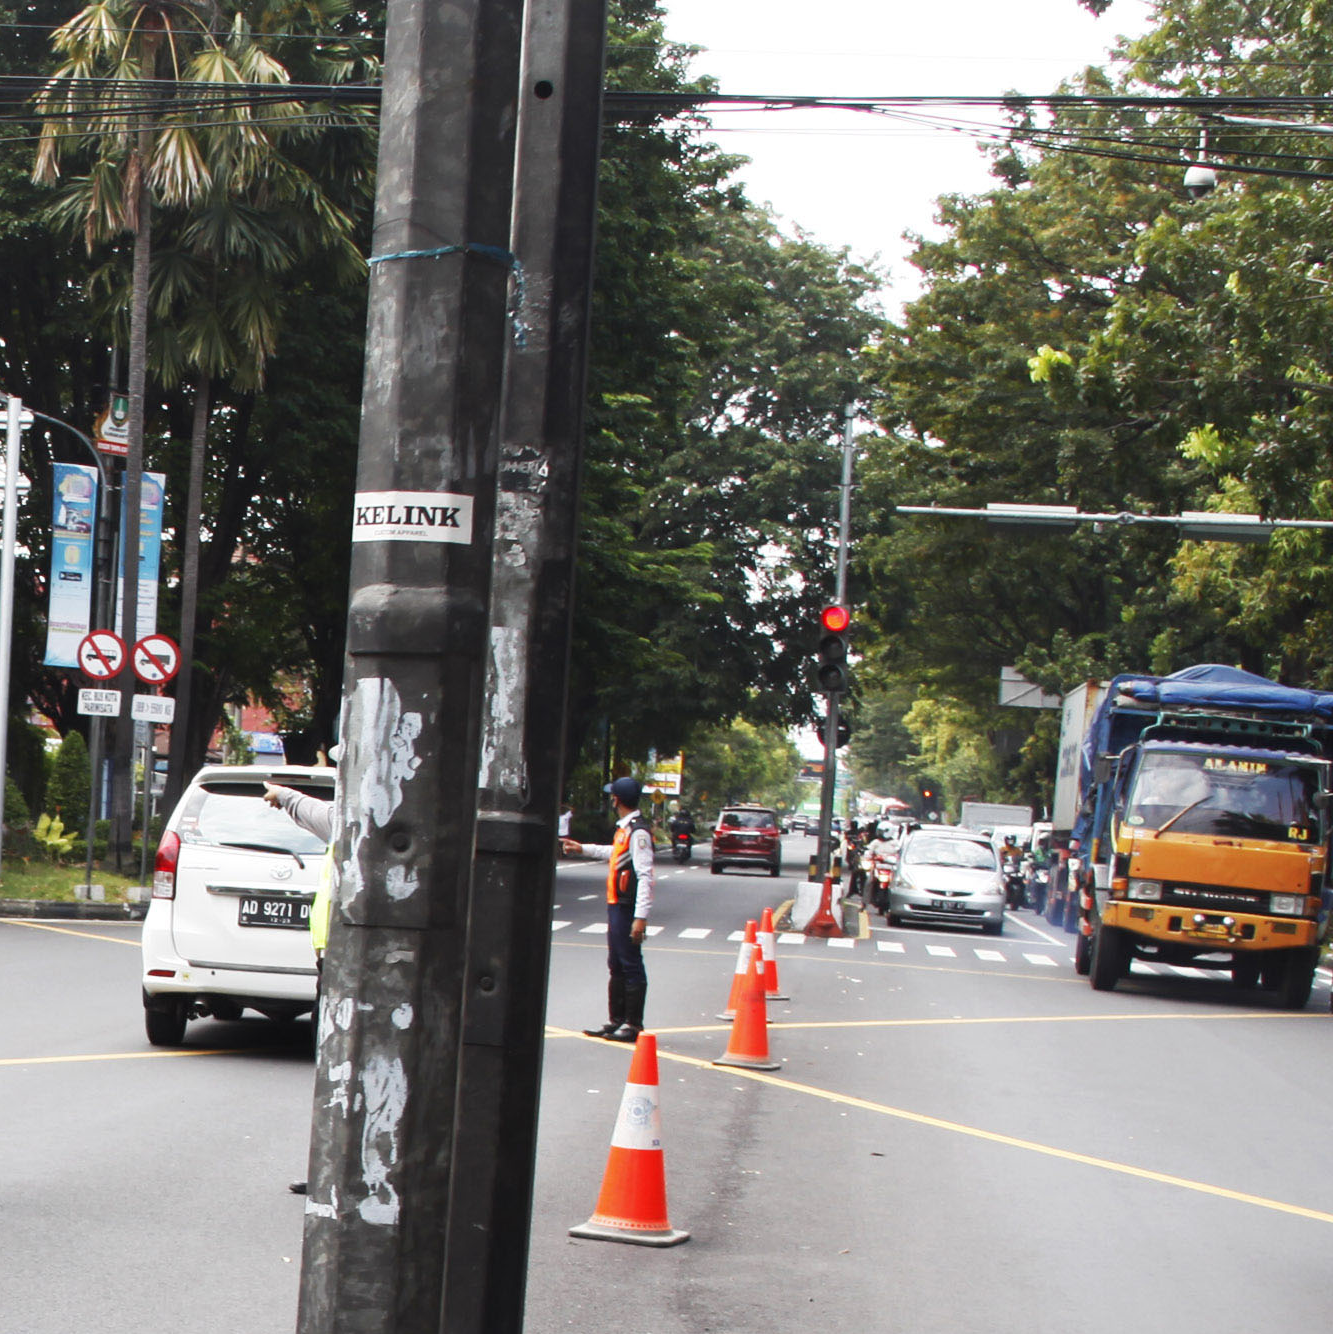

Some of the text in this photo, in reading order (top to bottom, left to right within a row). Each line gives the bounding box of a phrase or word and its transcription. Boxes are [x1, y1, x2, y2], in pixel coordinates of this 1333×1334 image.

[355, 505, 461, 529] KELINK
[1287, 826, 1308, 841] RJ
[242, 900, 312, 919] AD 9271 D
